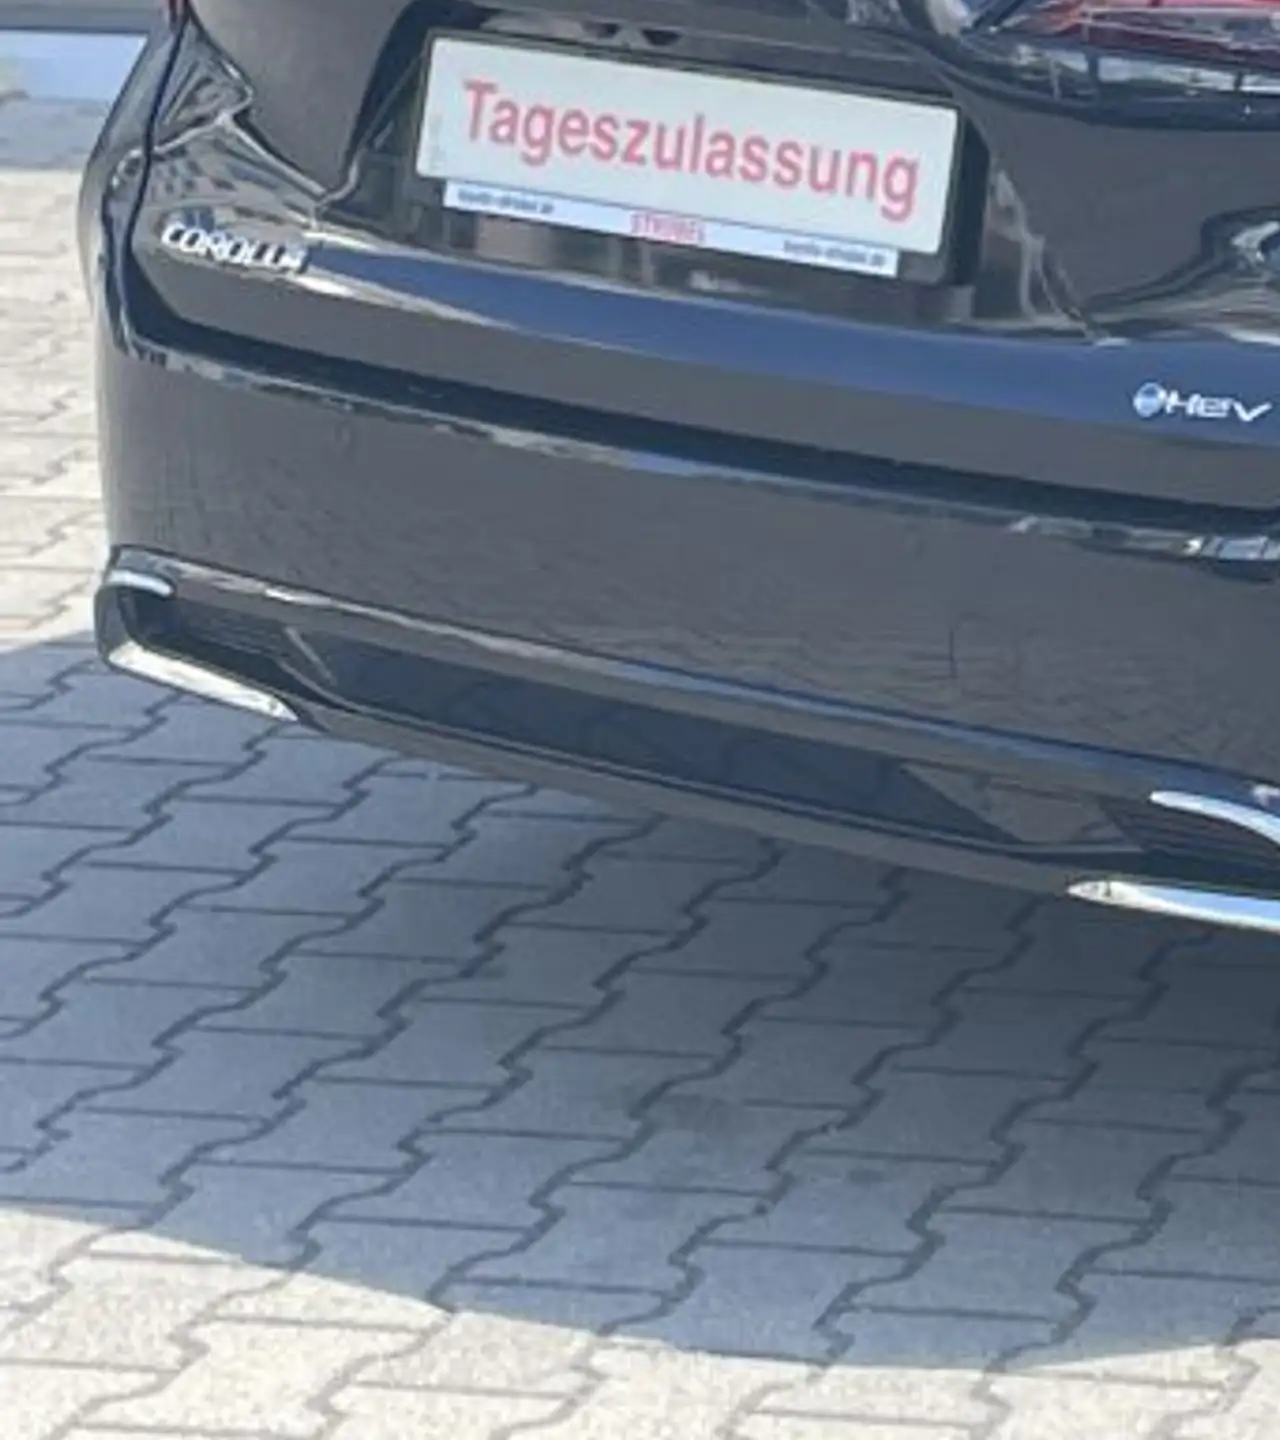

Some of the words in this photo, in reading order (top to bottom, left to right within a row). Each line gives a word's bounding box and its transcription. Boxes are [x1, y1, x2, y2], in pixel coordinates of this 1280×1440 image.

[463, 78, 919, 222] Tageszulassung
[161, 222, 306, 269] COROLLA
[1165, 389, 1273, 422] HEV
